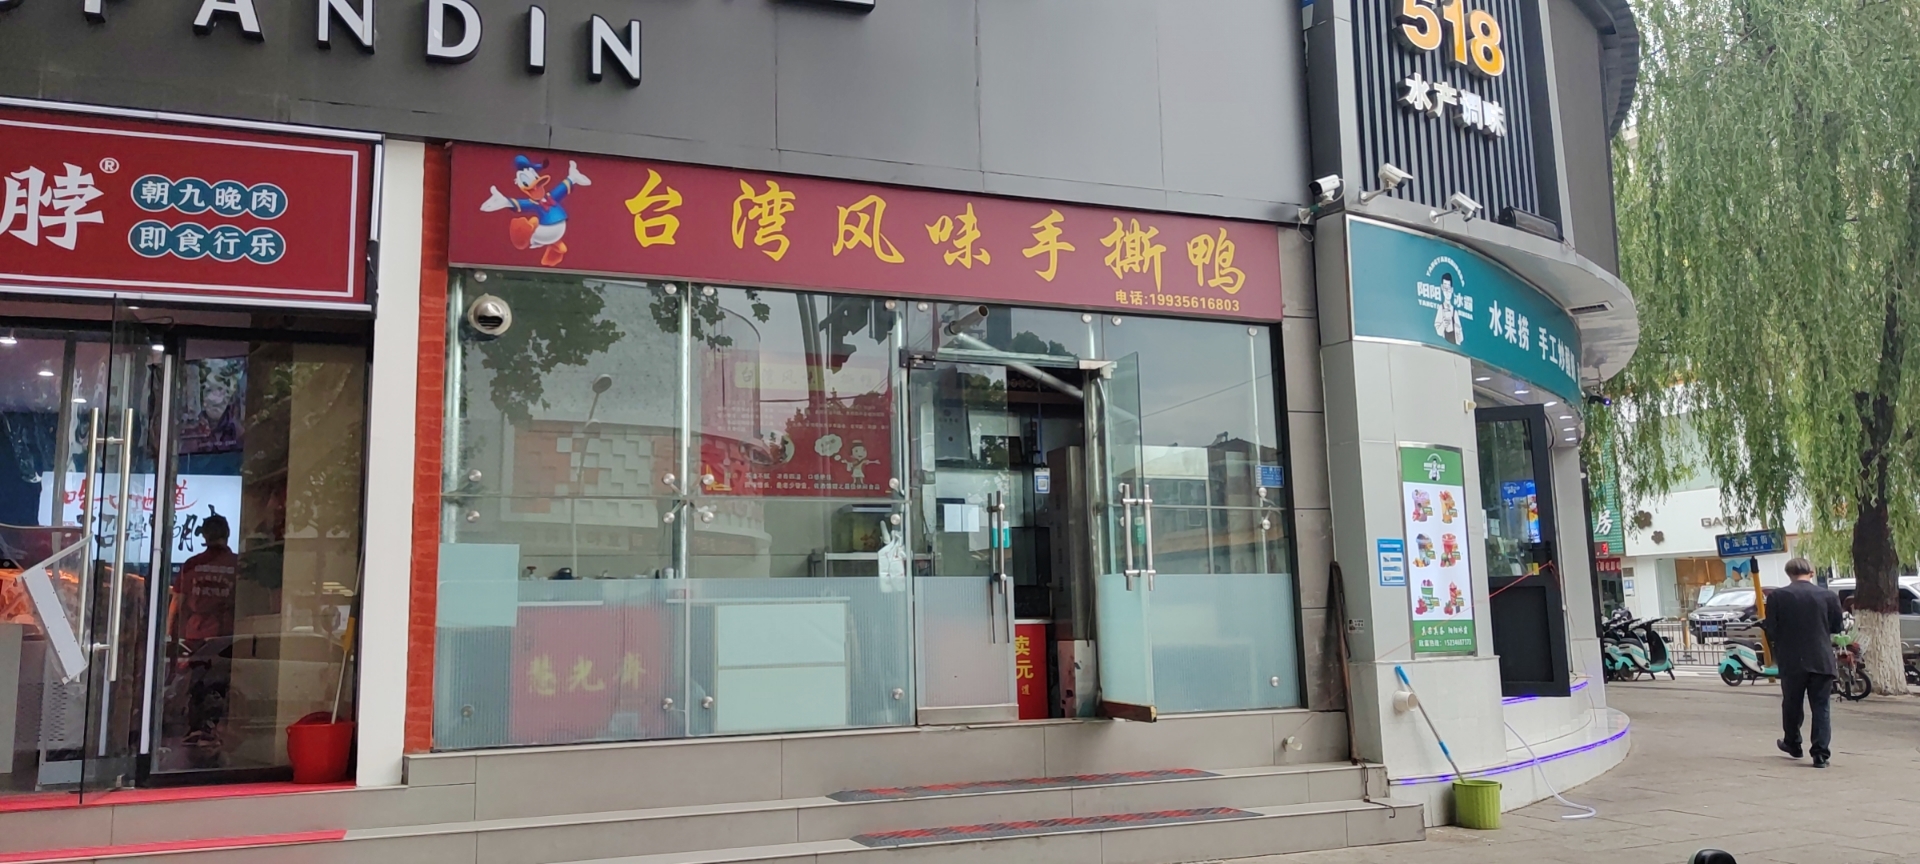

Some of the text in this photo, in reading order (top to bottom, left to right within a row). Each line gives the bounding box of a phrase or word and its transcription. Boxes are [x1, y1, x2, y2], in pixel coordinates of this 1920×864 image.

[84, 0, 643, 86] ANDIN
[1402, 0, 1505, 77] 518
[0, 162, 105, 251] 脖
[140, 180, 278, 213] 朝九晚肉
[138, 226, 277, 257] 即食行乐
[625, 168, 1247, 295] 台湾风味手撕鸭
[1115, 289, 1240, 312] 电话:19935616803
[1488, 299, 1530, 352] 水果捞
